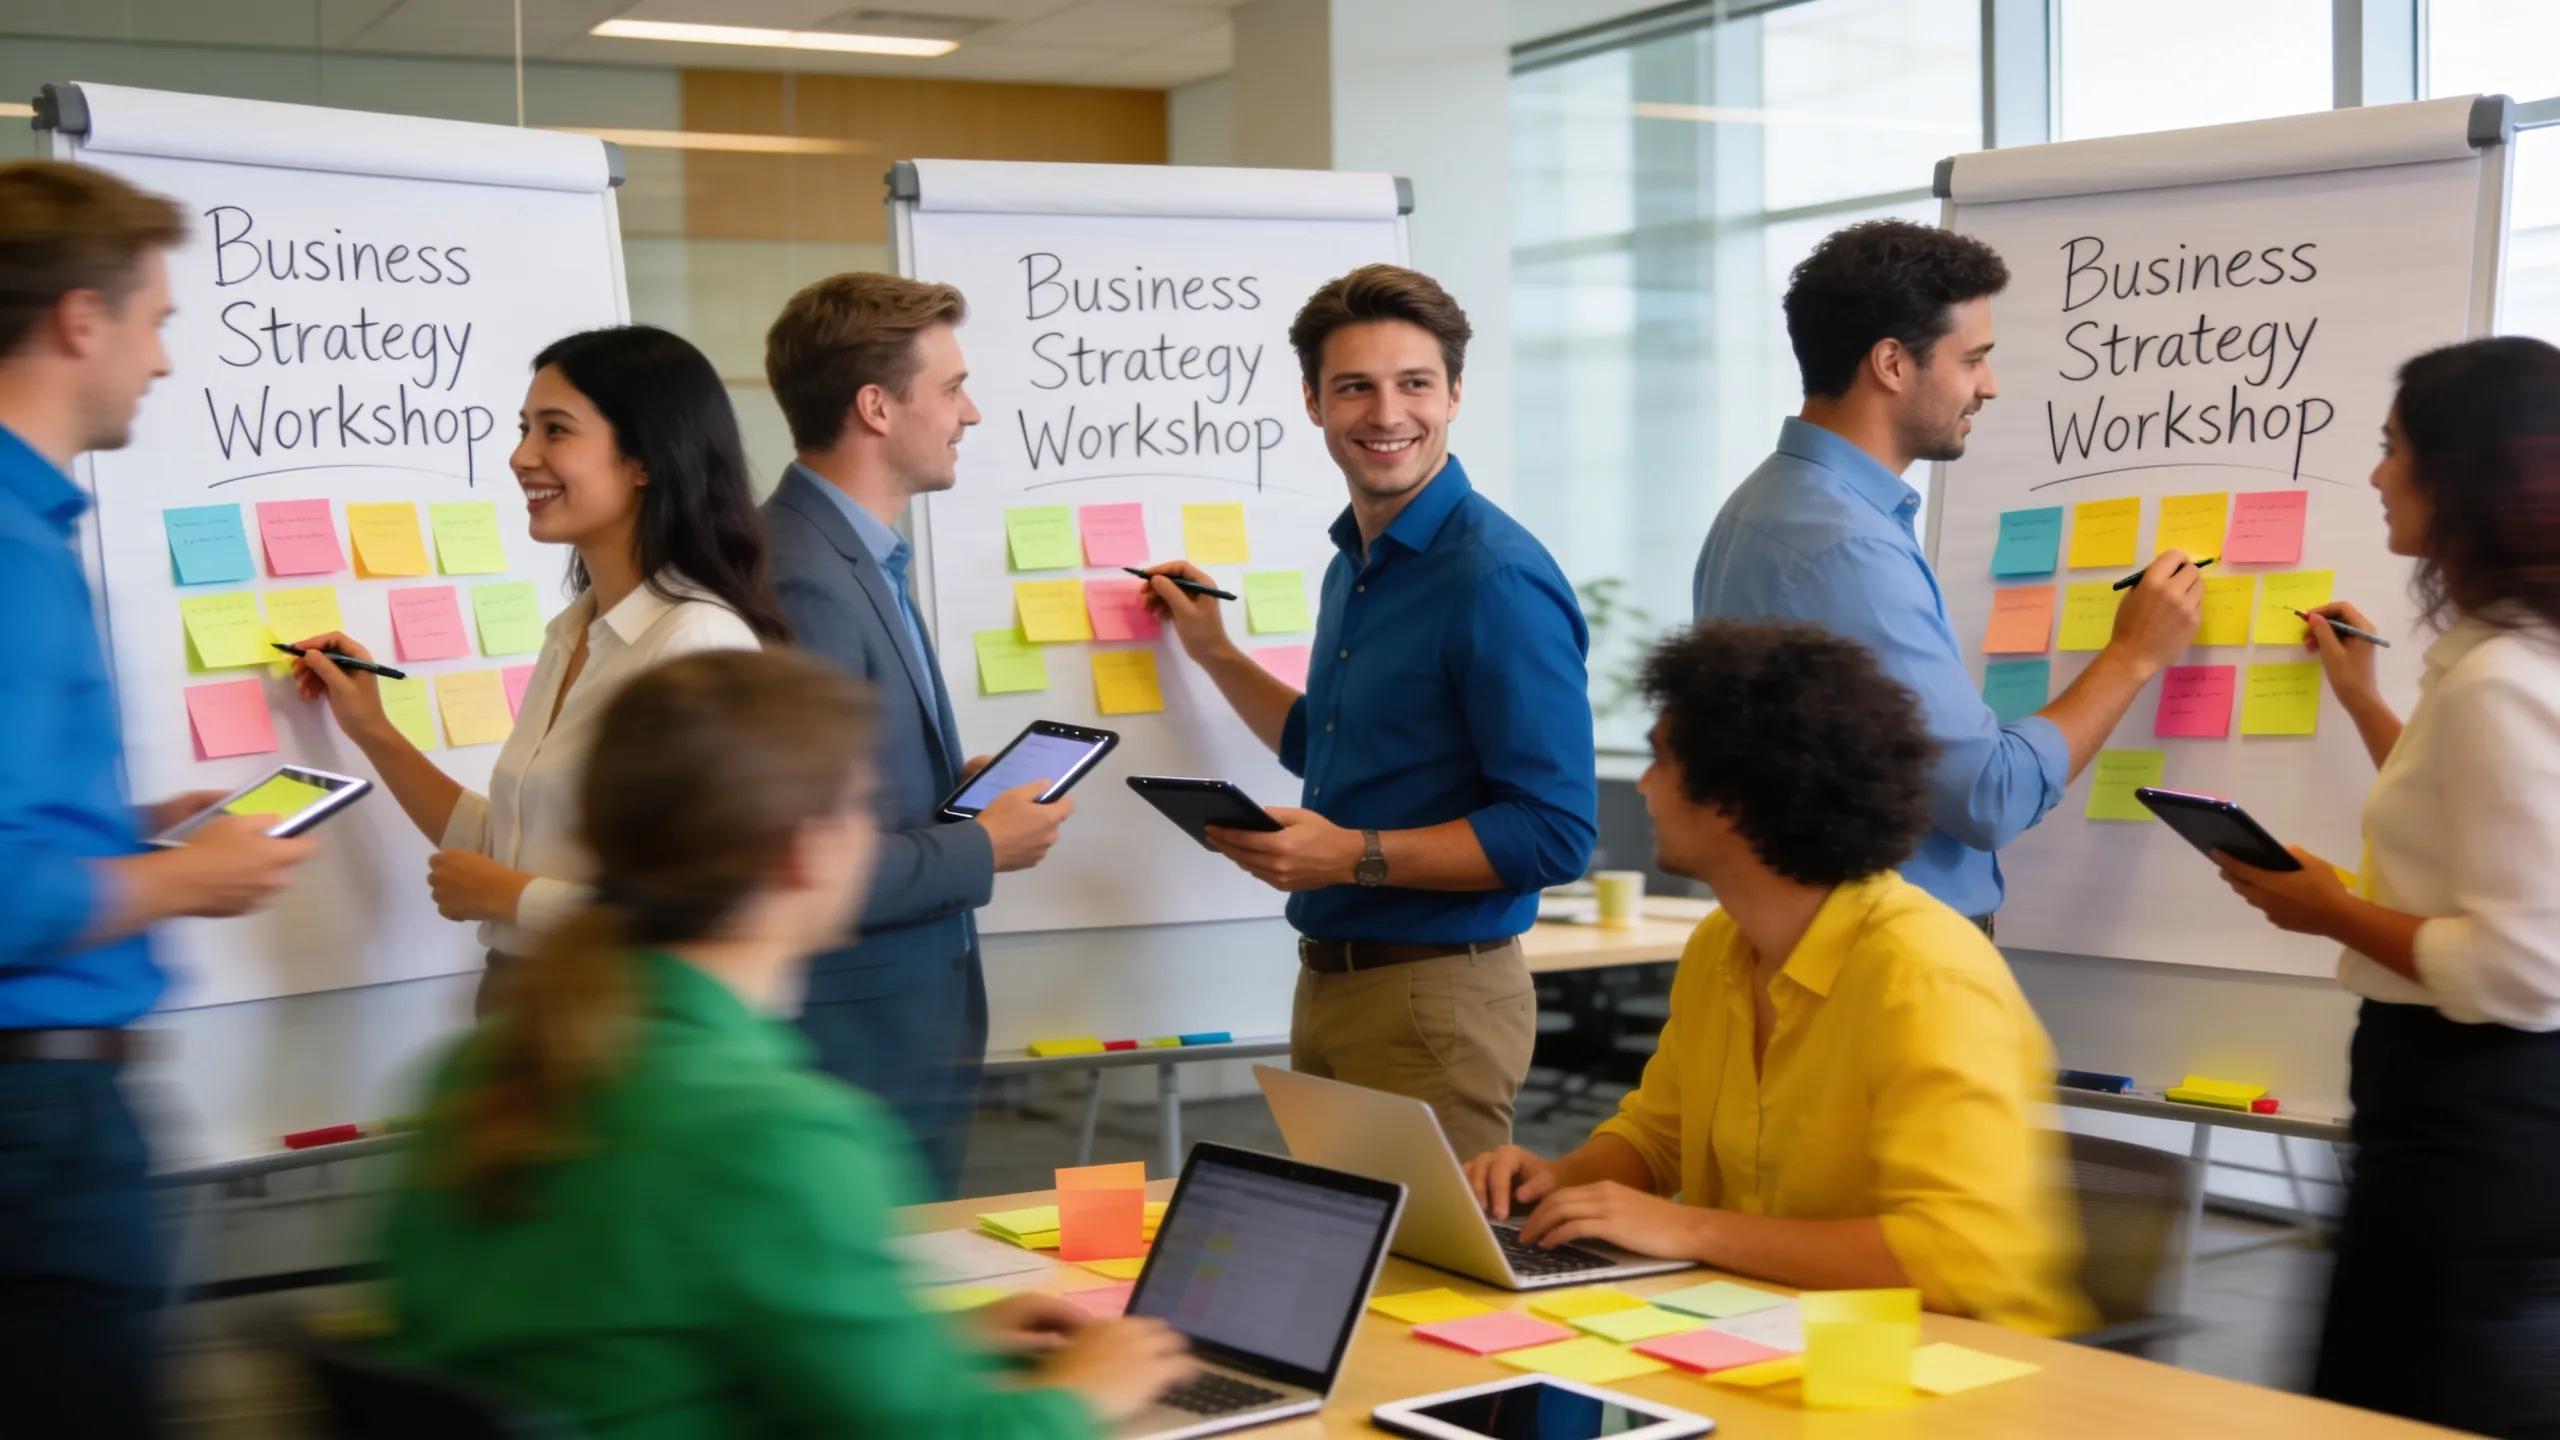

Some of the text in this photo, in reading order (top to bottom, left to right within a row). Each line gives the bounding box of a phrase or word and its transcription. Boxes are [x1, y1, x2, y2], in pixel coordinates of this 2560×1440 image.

[204, 205, 471, 287] Business
[1018, 251, 1262, 322] Business
[2060, 235, 2318, 312] Business
[218, 300, 473, 391] Strategy
[1030, 331, 1264, 405] Strategy
[2058, 313, 2319, 390] Strategy
[204, 384, 495, 488] Workshop
[1017, 400, 1285, 494] Workshop
[2046, 384, 2335, 482] Workshop
